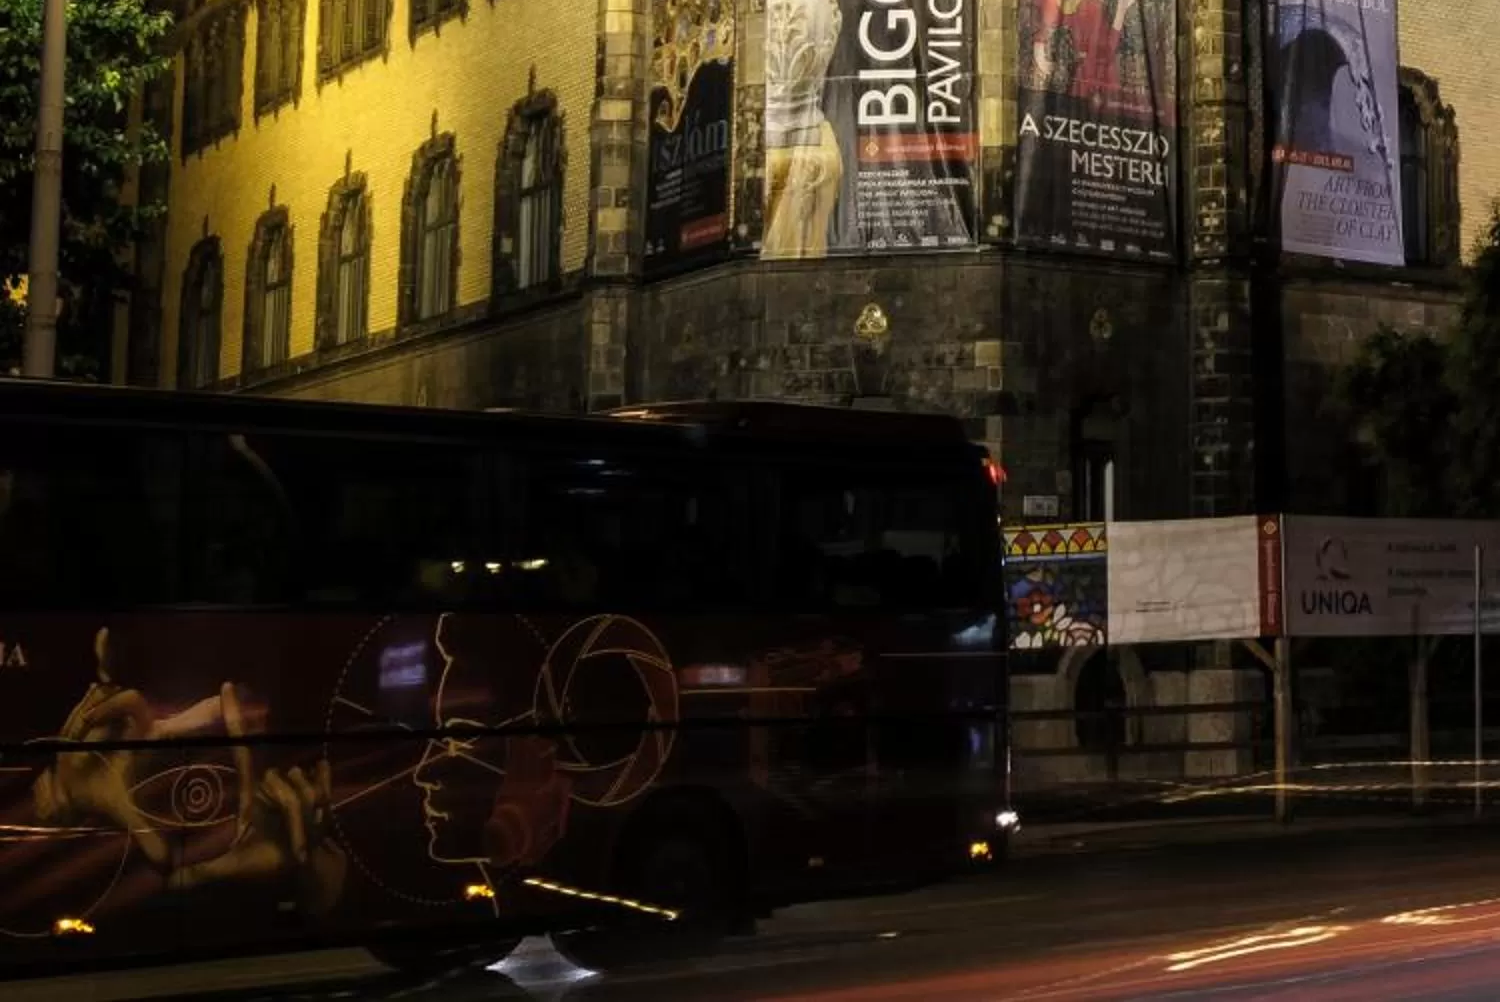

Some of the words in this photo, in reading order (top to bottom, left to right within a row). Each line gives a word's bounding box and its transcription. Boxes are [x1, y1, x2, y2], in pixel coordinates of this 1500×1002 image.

[1019, 113, 1039, 137] A
[1324, 175, 1355, 194] ART
[1298, 190, 1327, 211] THE
[1336, 217, 1357, 238] OF
[1301, 590, 1373, 615] UNIQA
